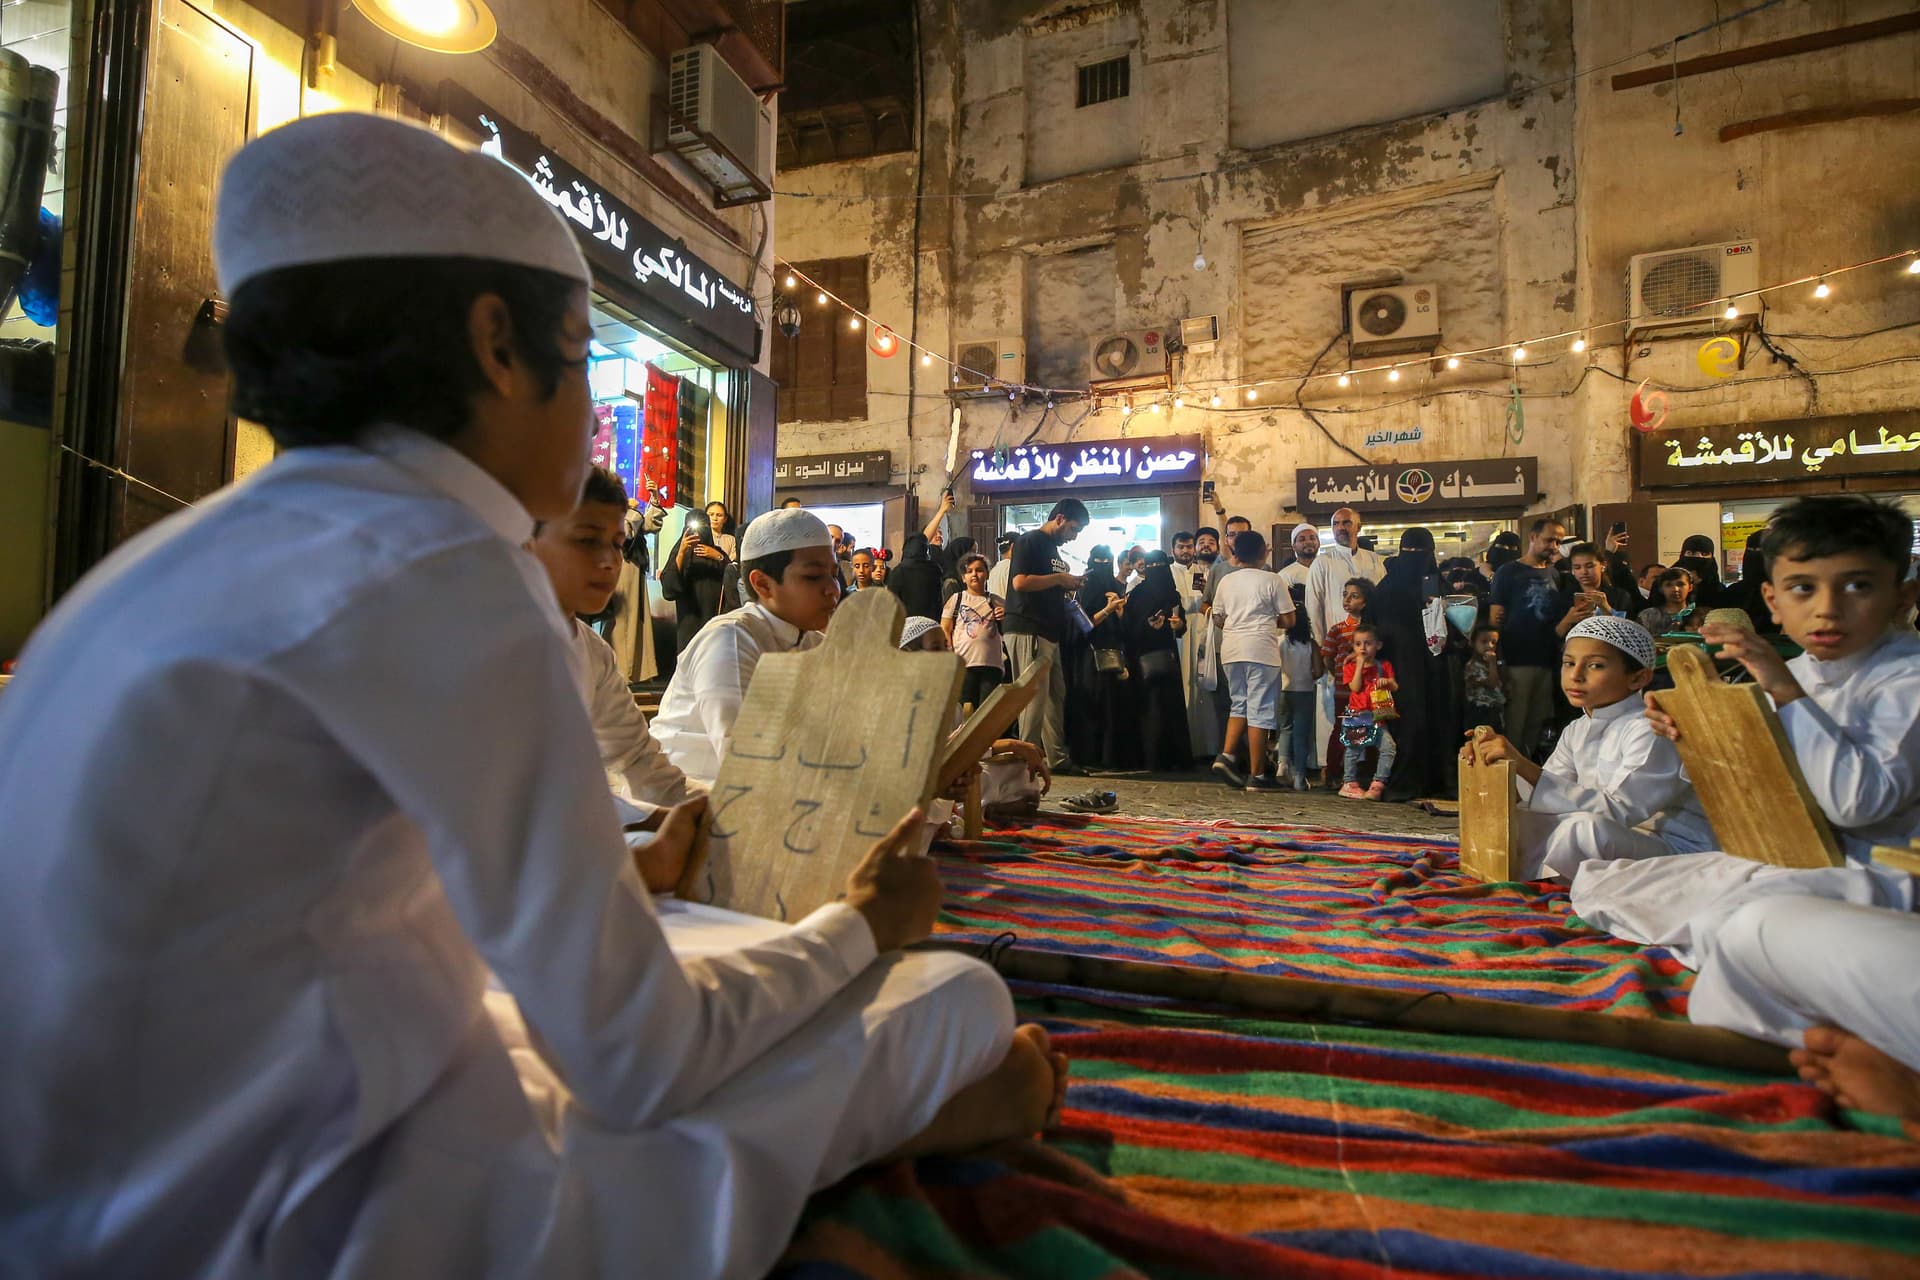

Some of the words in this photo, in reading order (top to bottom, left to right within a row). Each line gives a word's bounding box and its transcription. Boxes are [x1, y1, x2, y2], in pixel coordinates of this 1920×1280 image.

[1726, 245, 1753, 255] DORA
[632, 247, 716, 309] المالكي
[1416, 304, 1430, 313] LG
[1146, 346, 1158, 354] LG
[1365, 431, 1393, 446] الخير
[1393, 426, 1422, 444] شهر
[1664, 431, 1795, 467] للأقمشة
[1065, 446, 1132, 484] المنظر
[1136, 445, 1197, 480] حصن
[1308, 469, 1390, 504] للأقمشة
[1439, 465, 1525, 499] فدك
